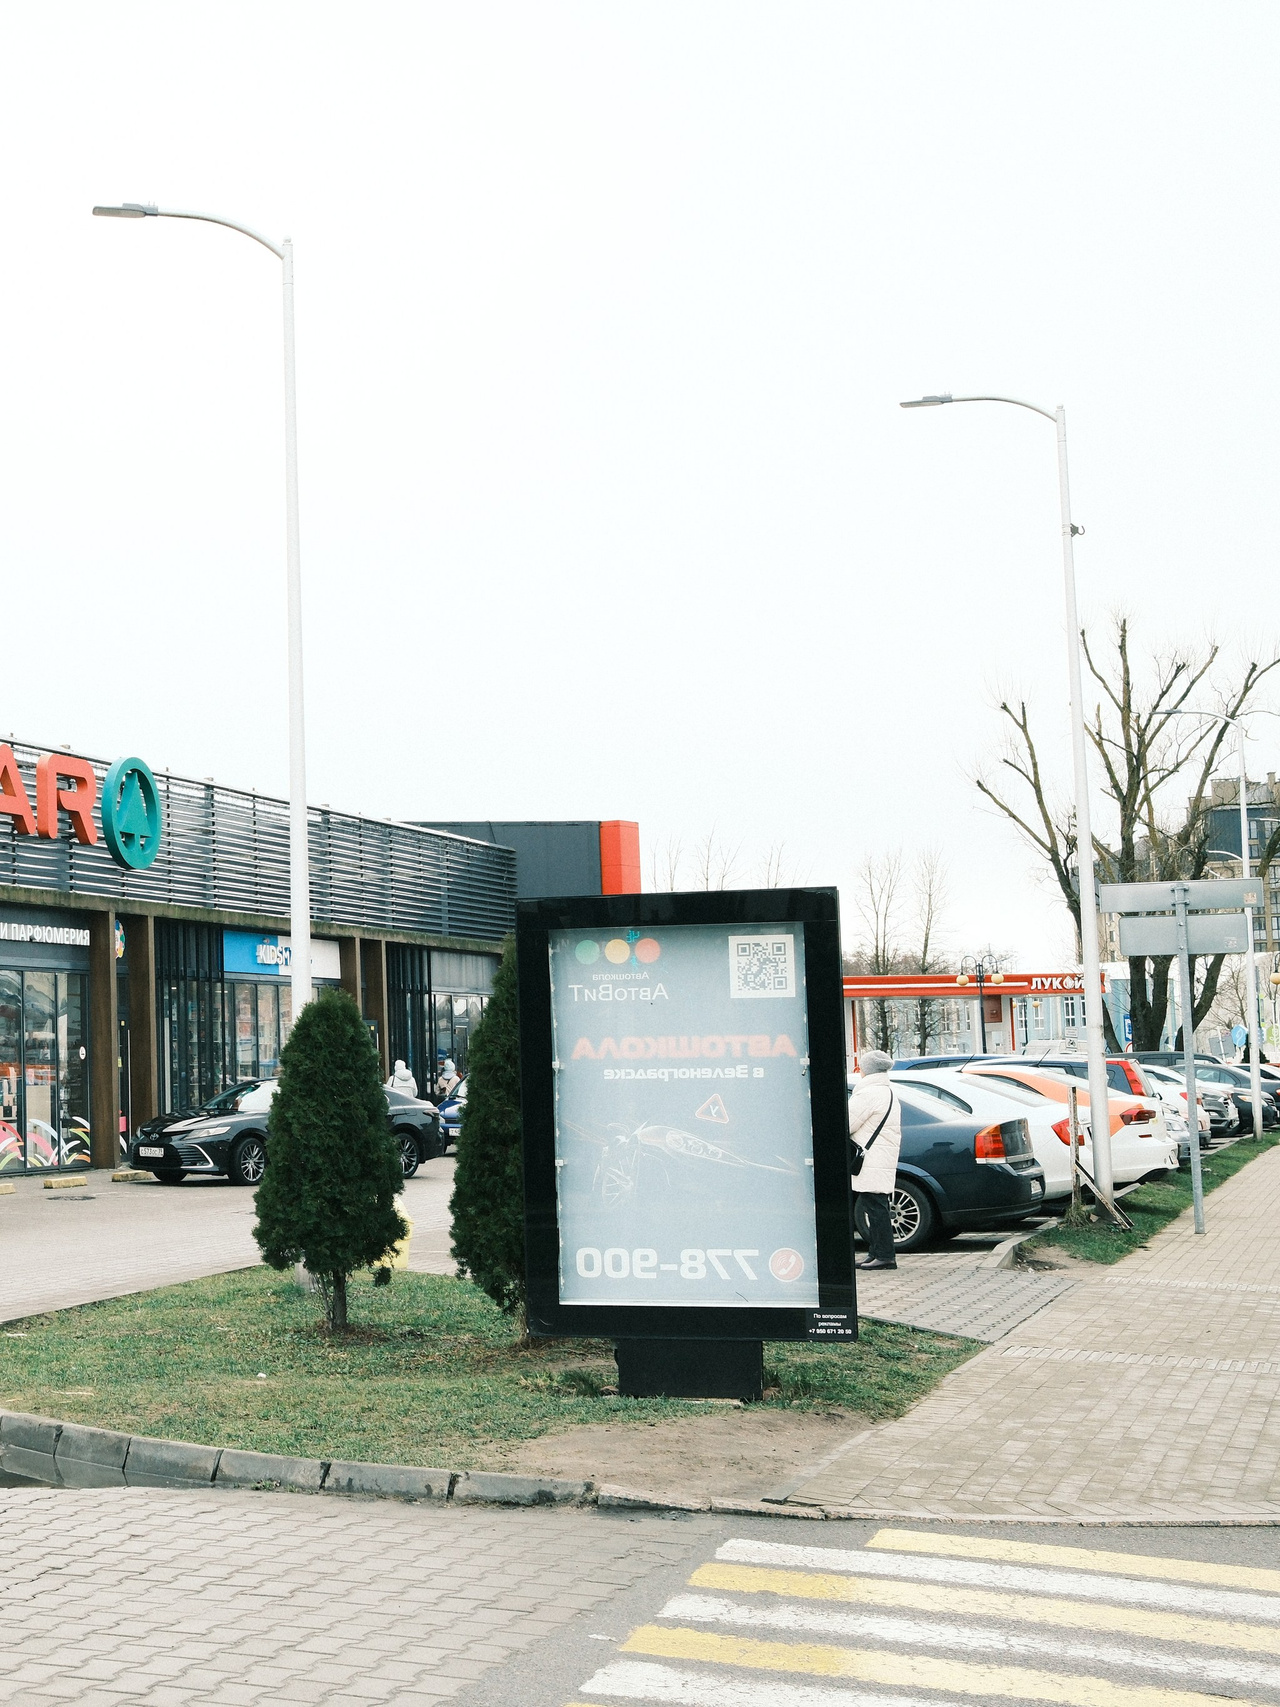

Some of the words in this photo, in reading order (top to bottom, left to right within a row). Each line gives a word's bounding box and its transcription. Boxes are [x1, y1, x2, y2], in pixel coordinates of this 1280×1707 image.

[0, 922, 9, 940] И
[11, 923, 91, 946] ПАРФЮМЕРИЯ
[256, 944, 293, 966] KIDSM
[1031, 974, 1085, 990] ЛУКОЙ
